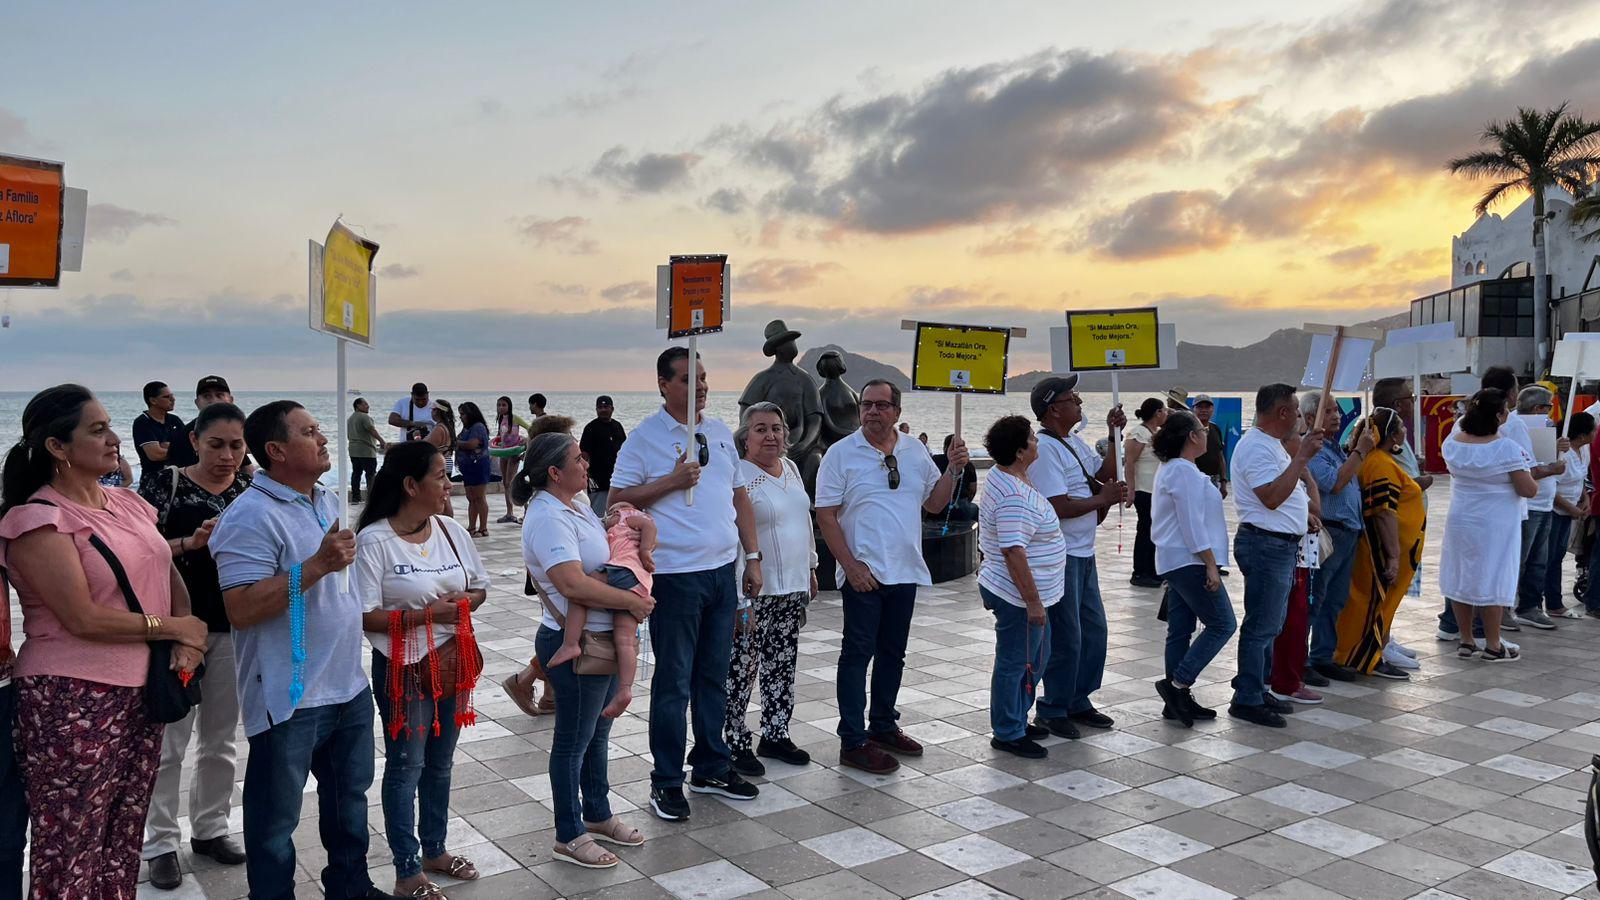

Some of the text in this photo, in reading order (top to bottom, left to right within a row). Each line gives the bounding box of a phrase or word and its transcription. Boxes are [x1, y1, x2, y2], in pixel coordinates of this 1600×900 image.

[6, 189, 39, 204] Familia
[6, 210, 37, 224] Aflora"
[939, 351, 955, 359] Todo
[393, 564, 461, 575] Champion
